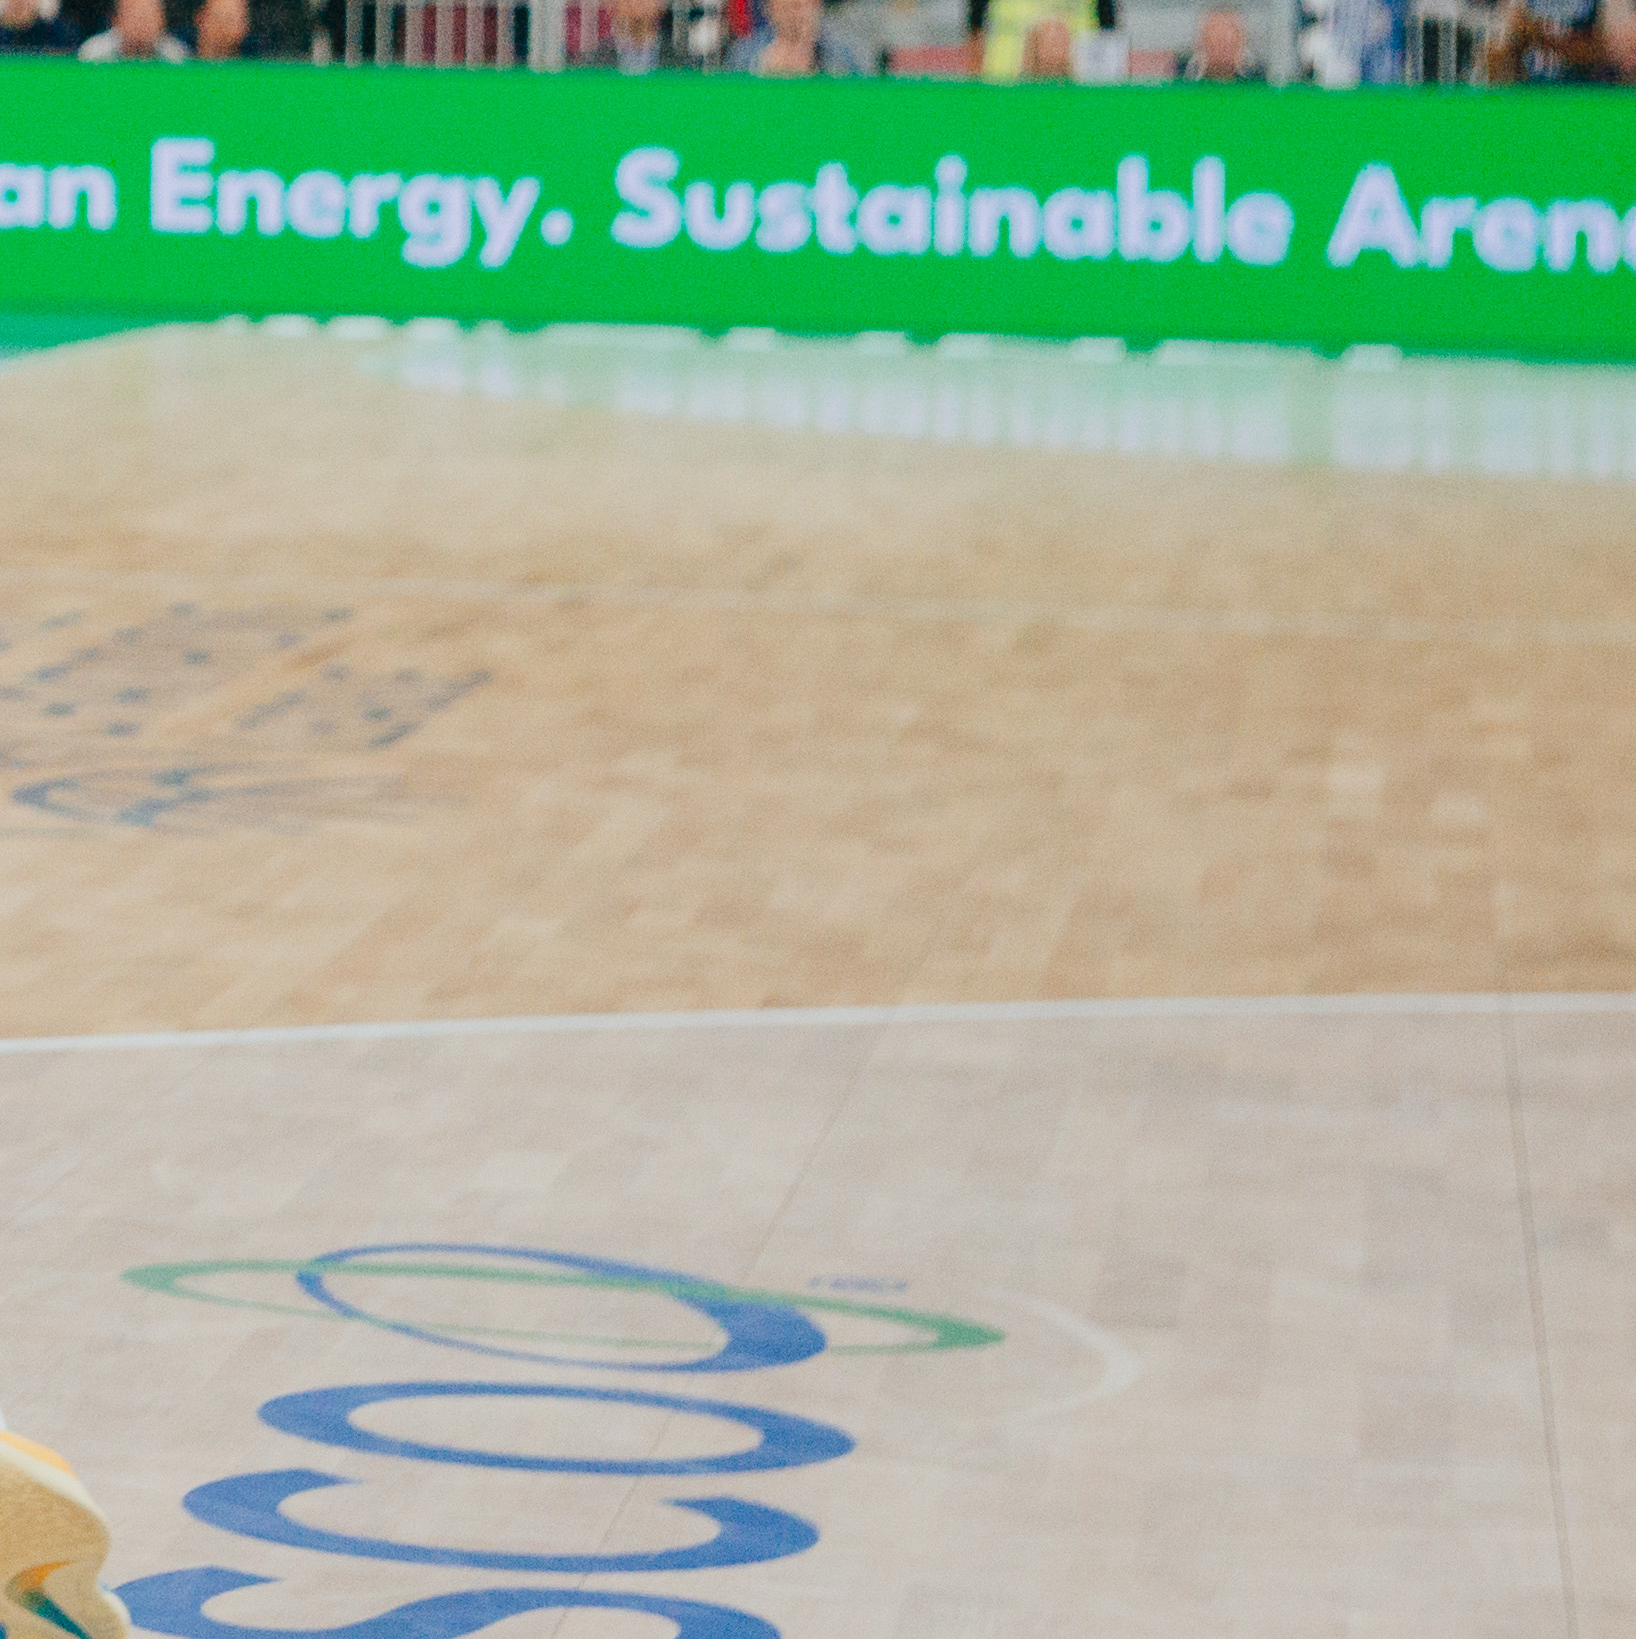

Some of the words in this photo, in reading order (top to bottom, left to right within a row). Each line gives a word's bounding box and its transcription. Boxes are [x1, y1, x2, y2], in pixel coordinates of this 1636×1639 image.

[149, 137, 575, 269] Energy.
[610, 144, 1295, 267] Sustainable
[1327, 162, 1636, 274] Aren
